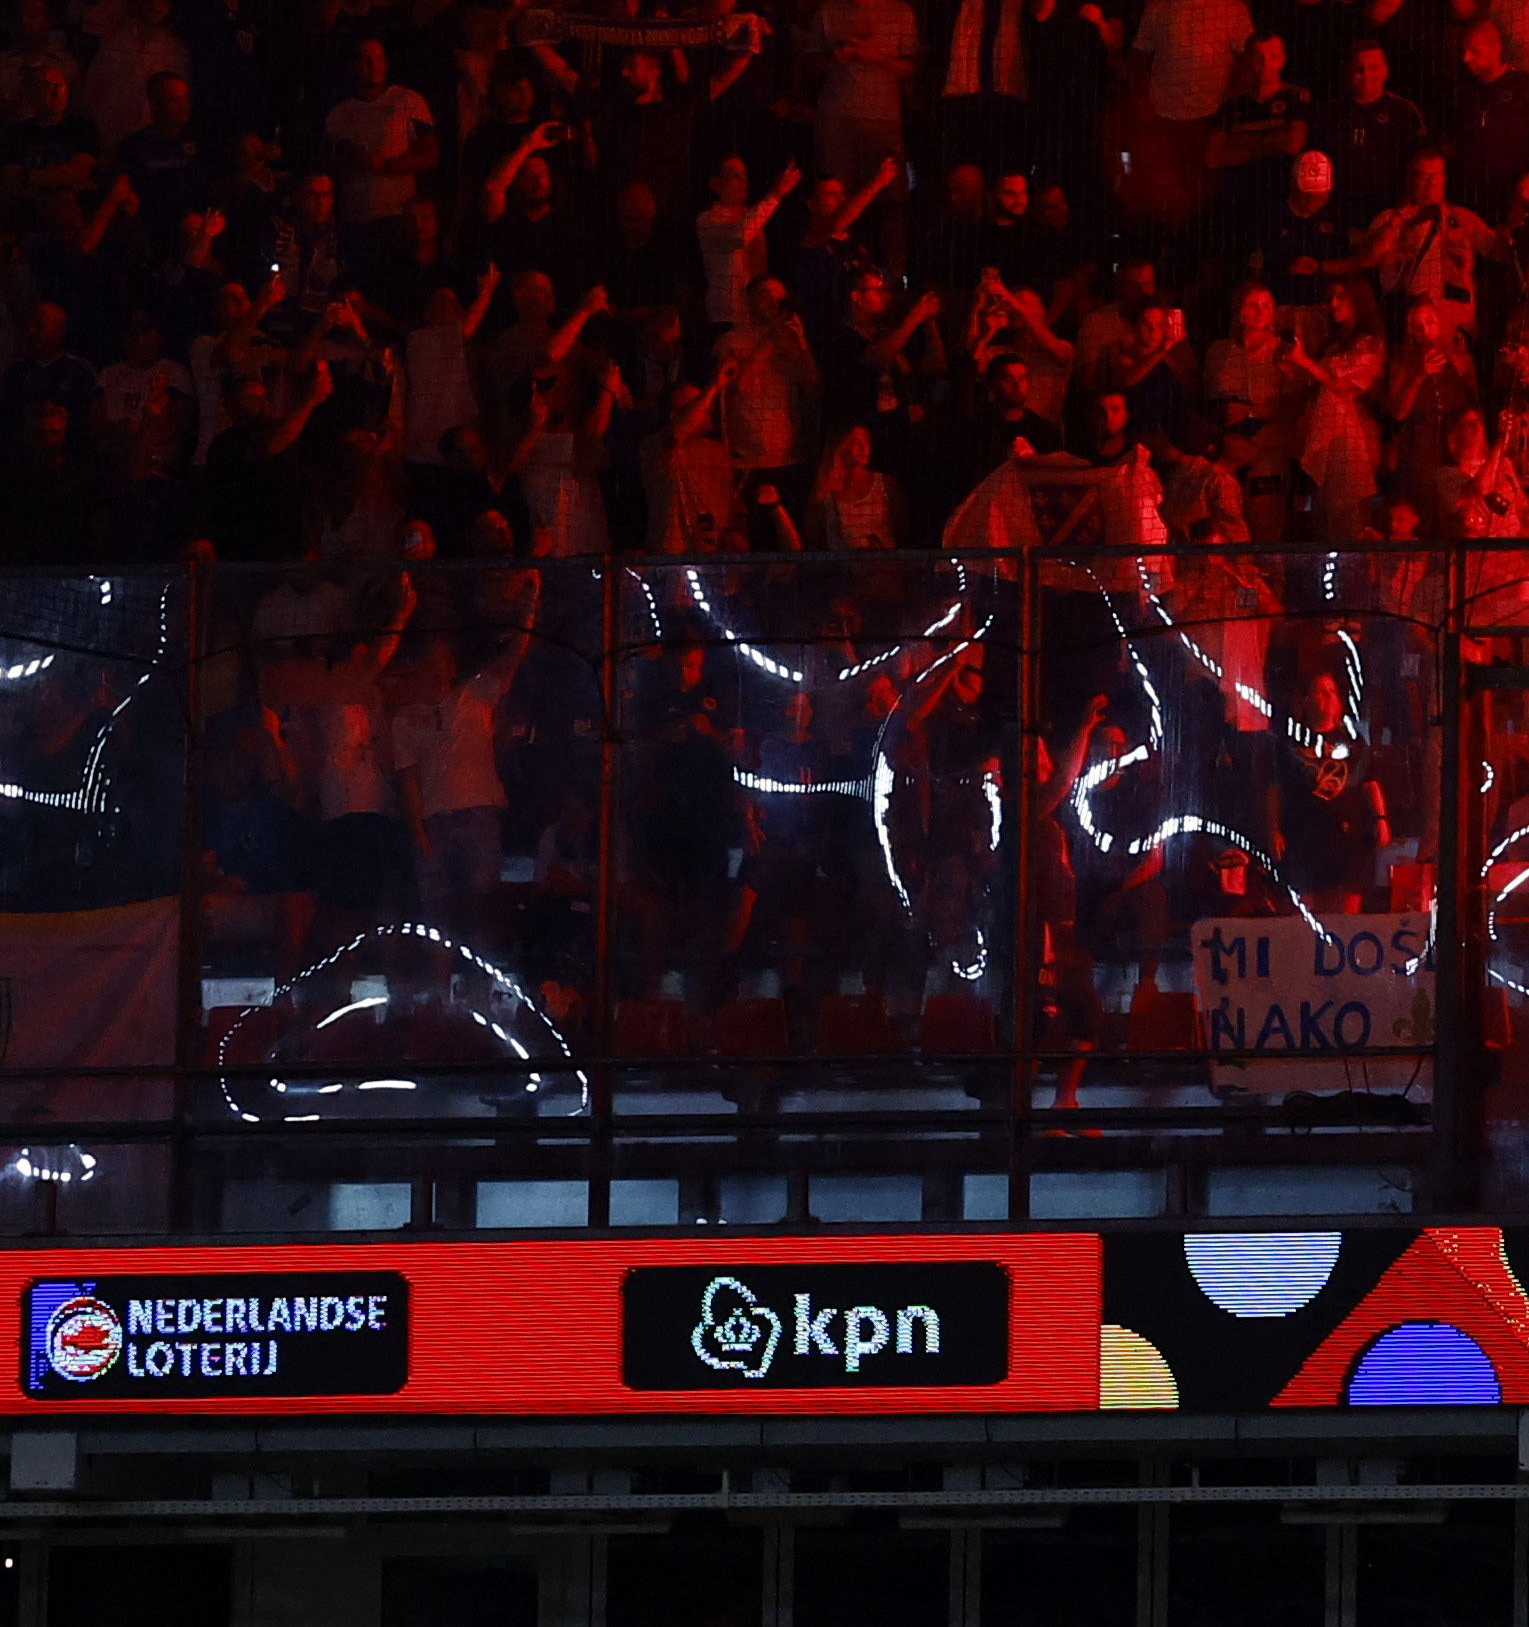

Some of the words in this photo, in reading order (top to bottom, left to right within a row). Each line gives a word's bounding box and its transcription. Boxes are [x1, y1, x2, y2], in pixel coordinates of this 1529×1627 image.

[1210, 930, 1270, 980] MI
[126, 1294, 388, 1334] NEDERLANDSE
[793, 1292, 940, 1372] kpn
[126, 1339, 279, 1377] LOTERIJ
